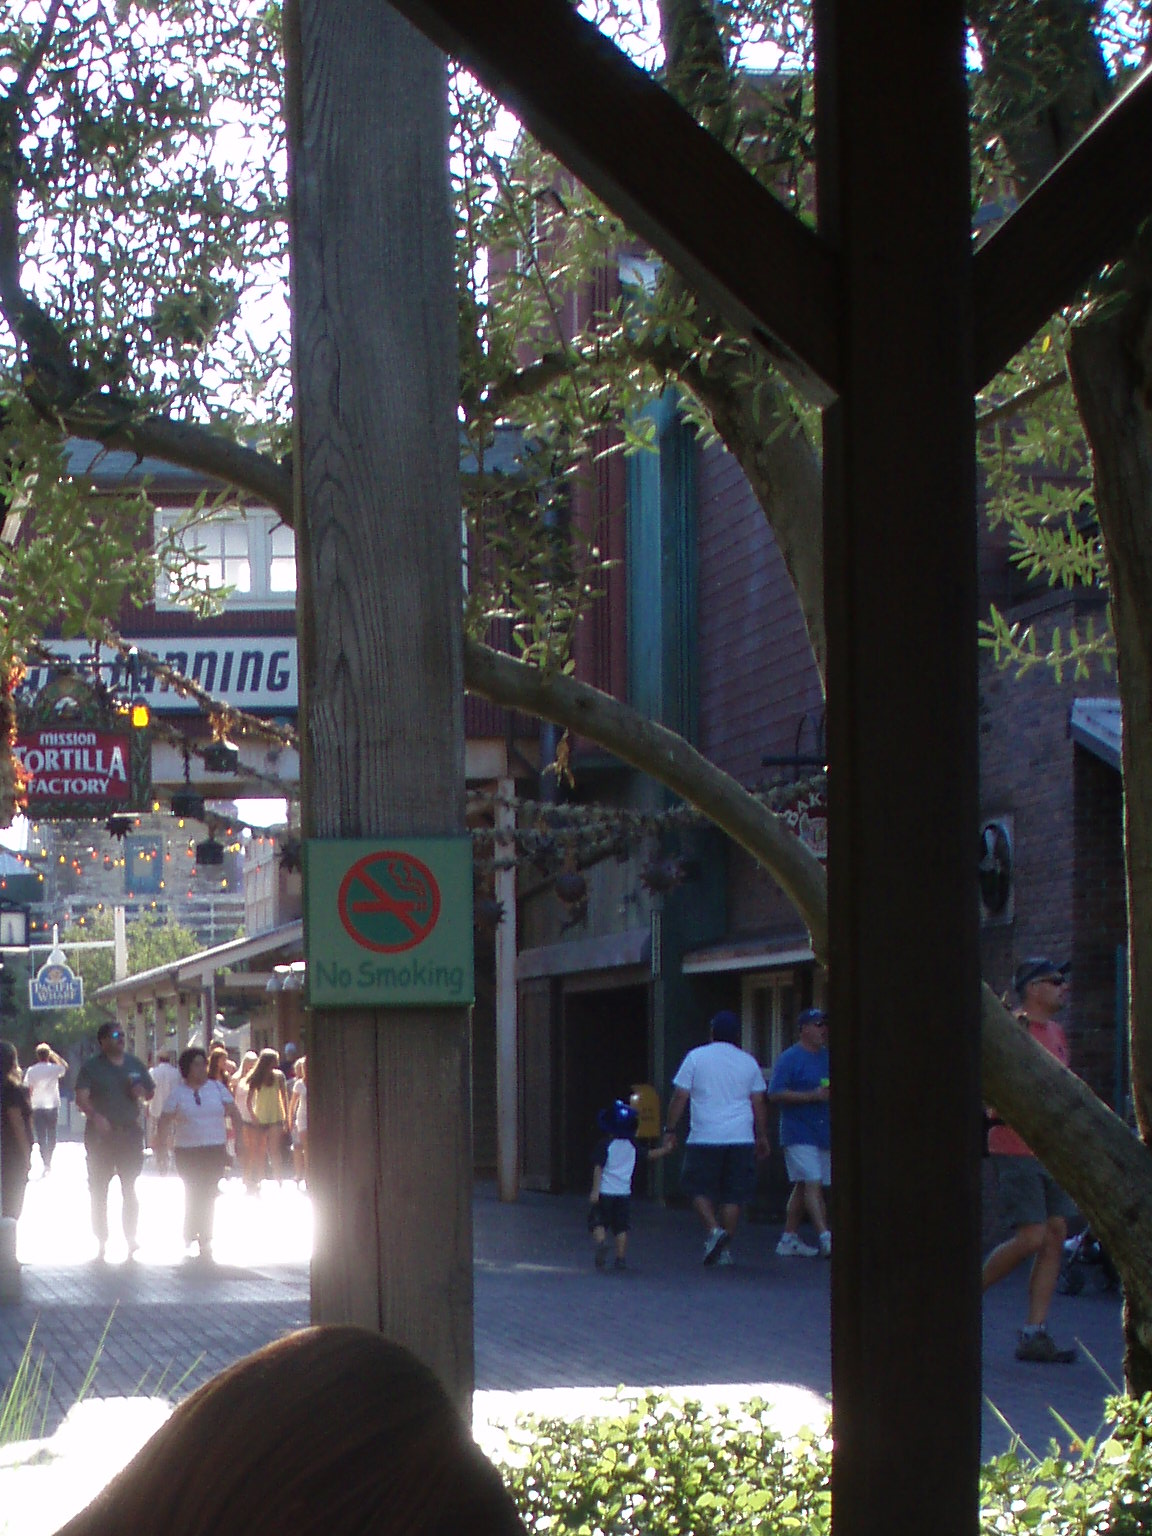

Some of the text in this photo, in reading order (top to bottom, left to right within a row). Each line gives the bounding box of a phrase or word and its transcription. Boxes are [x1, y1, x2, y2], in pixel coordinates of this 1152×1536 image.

[27, 777, 110, 795] FACTORY
[316, 959, 464, 995] No Smoking
